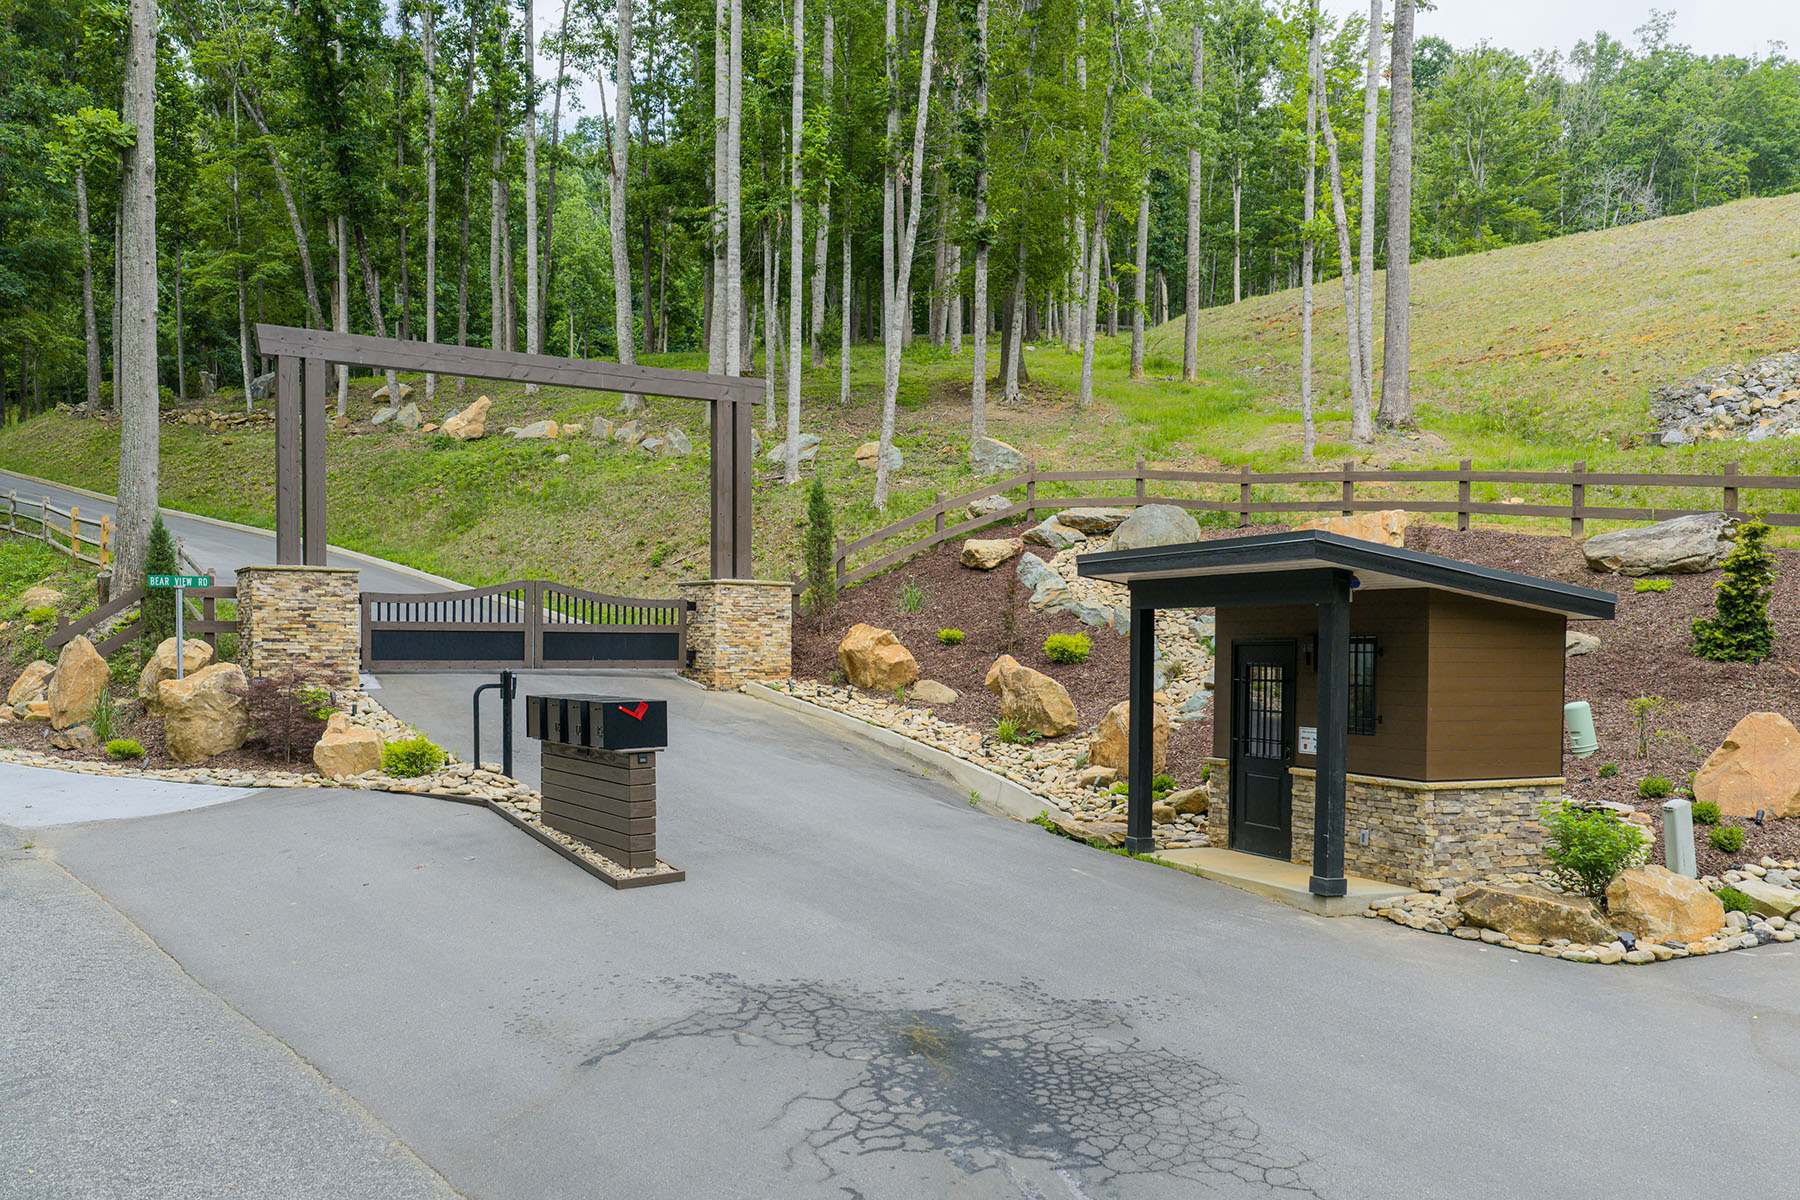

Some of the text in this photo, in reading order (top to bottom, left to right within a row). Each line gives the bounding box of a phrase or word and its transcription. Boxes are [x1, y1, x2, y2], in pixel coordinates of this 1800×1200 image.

[150, 577, 208, 587] BEAR VIEW RD
